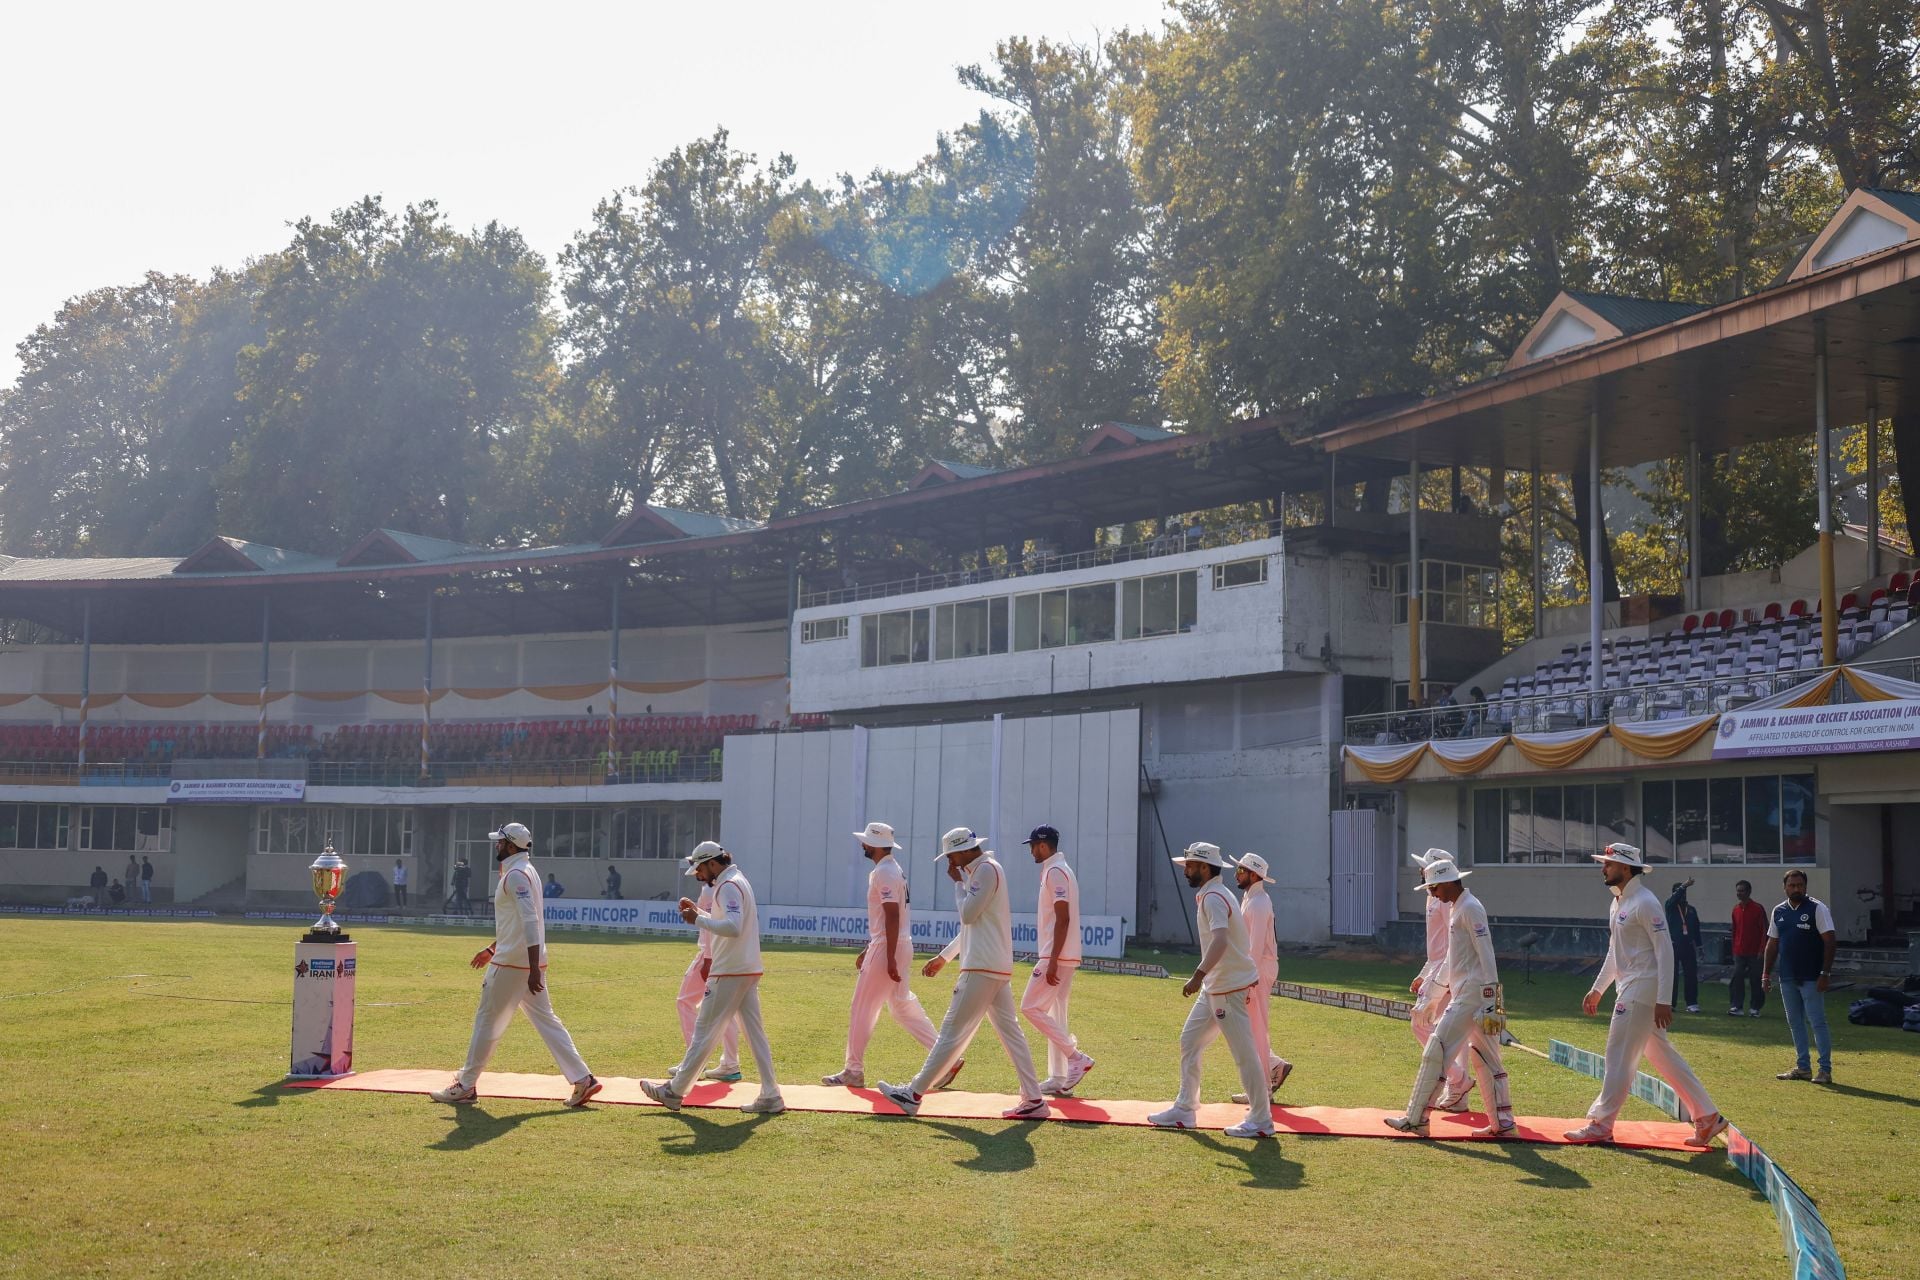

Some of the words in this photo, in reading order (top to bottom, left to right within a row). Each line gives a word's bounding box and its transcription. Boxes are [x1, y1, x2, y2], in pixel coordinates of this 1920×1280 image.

[1740, 717, 1769, 728] JAMMU
[1770, 717, 1776, 727] &
[1778, 714, 1814, 726] KASHMIR
[1816, 711, 1848, 724] CRICKET
[1849, 707, 1903, 721] ASSOCIATION
[1749, 732, 1780, 741] AFFILIATED
[1781, 732, 1789, 740] TO
[1790, 730, 1811, 739] BOARD
[1812, 729, 1820, 738] OF
[1821, 727, 1849, 738] CONTROL
[1850, 726, 1862, 735] FOR
[1863, 725, 1888, 735] CRICKET
[1889, 724, 1896, 732] IN
[1897, 723, 1915, 732] INDIA
[544, 906, 577, 920] thoot
[582, 907, 638, 922] FINCORP
[649, 909, 684, 924] mutho
[769, 915, 816, 931] muthoot
[936, 920, 961, 938] FINC
[1011, 923, 1038, 941] utho
[310, 970, 335, 978] IRANI
